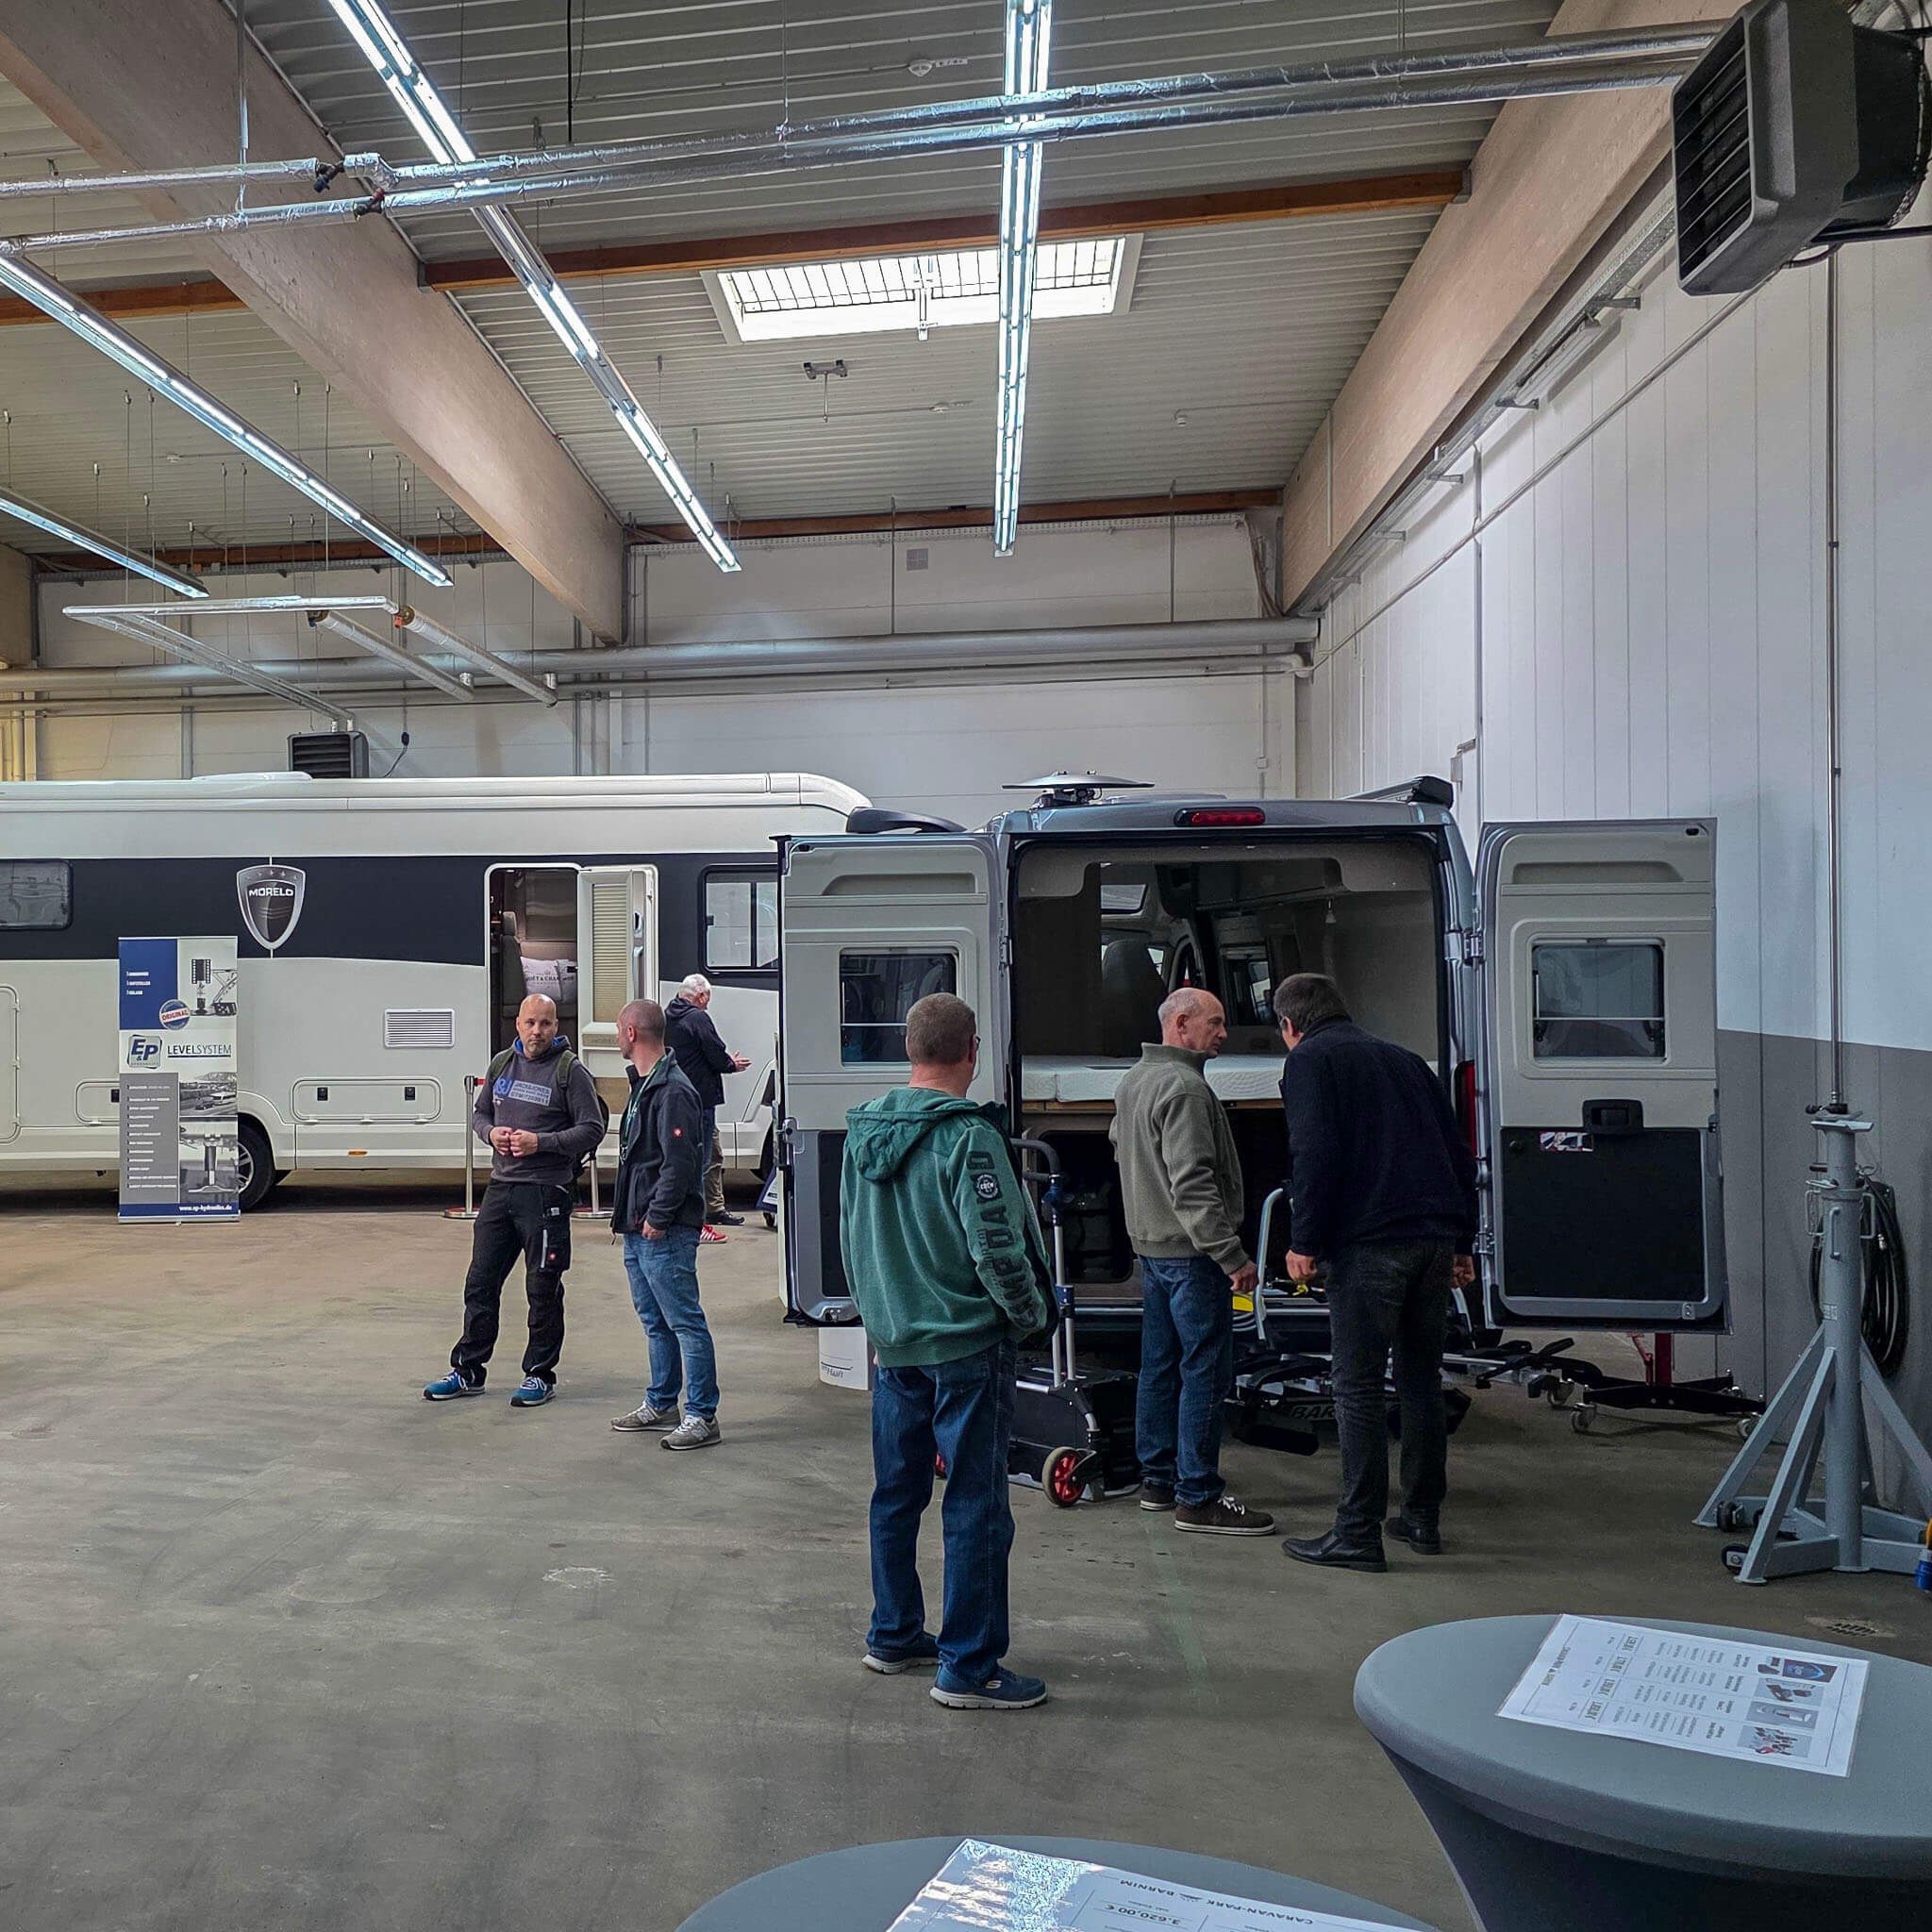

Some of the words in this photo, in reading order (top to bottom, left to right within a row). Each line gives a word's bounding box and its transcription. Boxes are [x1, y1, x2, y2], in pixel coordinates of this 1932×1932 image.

[248, 887, 294, 897] MORELO
[161, 1008, 189, 1021] ORIGINAL
[167, 1044, 232, 1055] LEVELSYSTEM
[1120, 1879, 1175, 1897] BARNIM
[1207, 1899, 1314, 1925] CARAVAN-PARK
